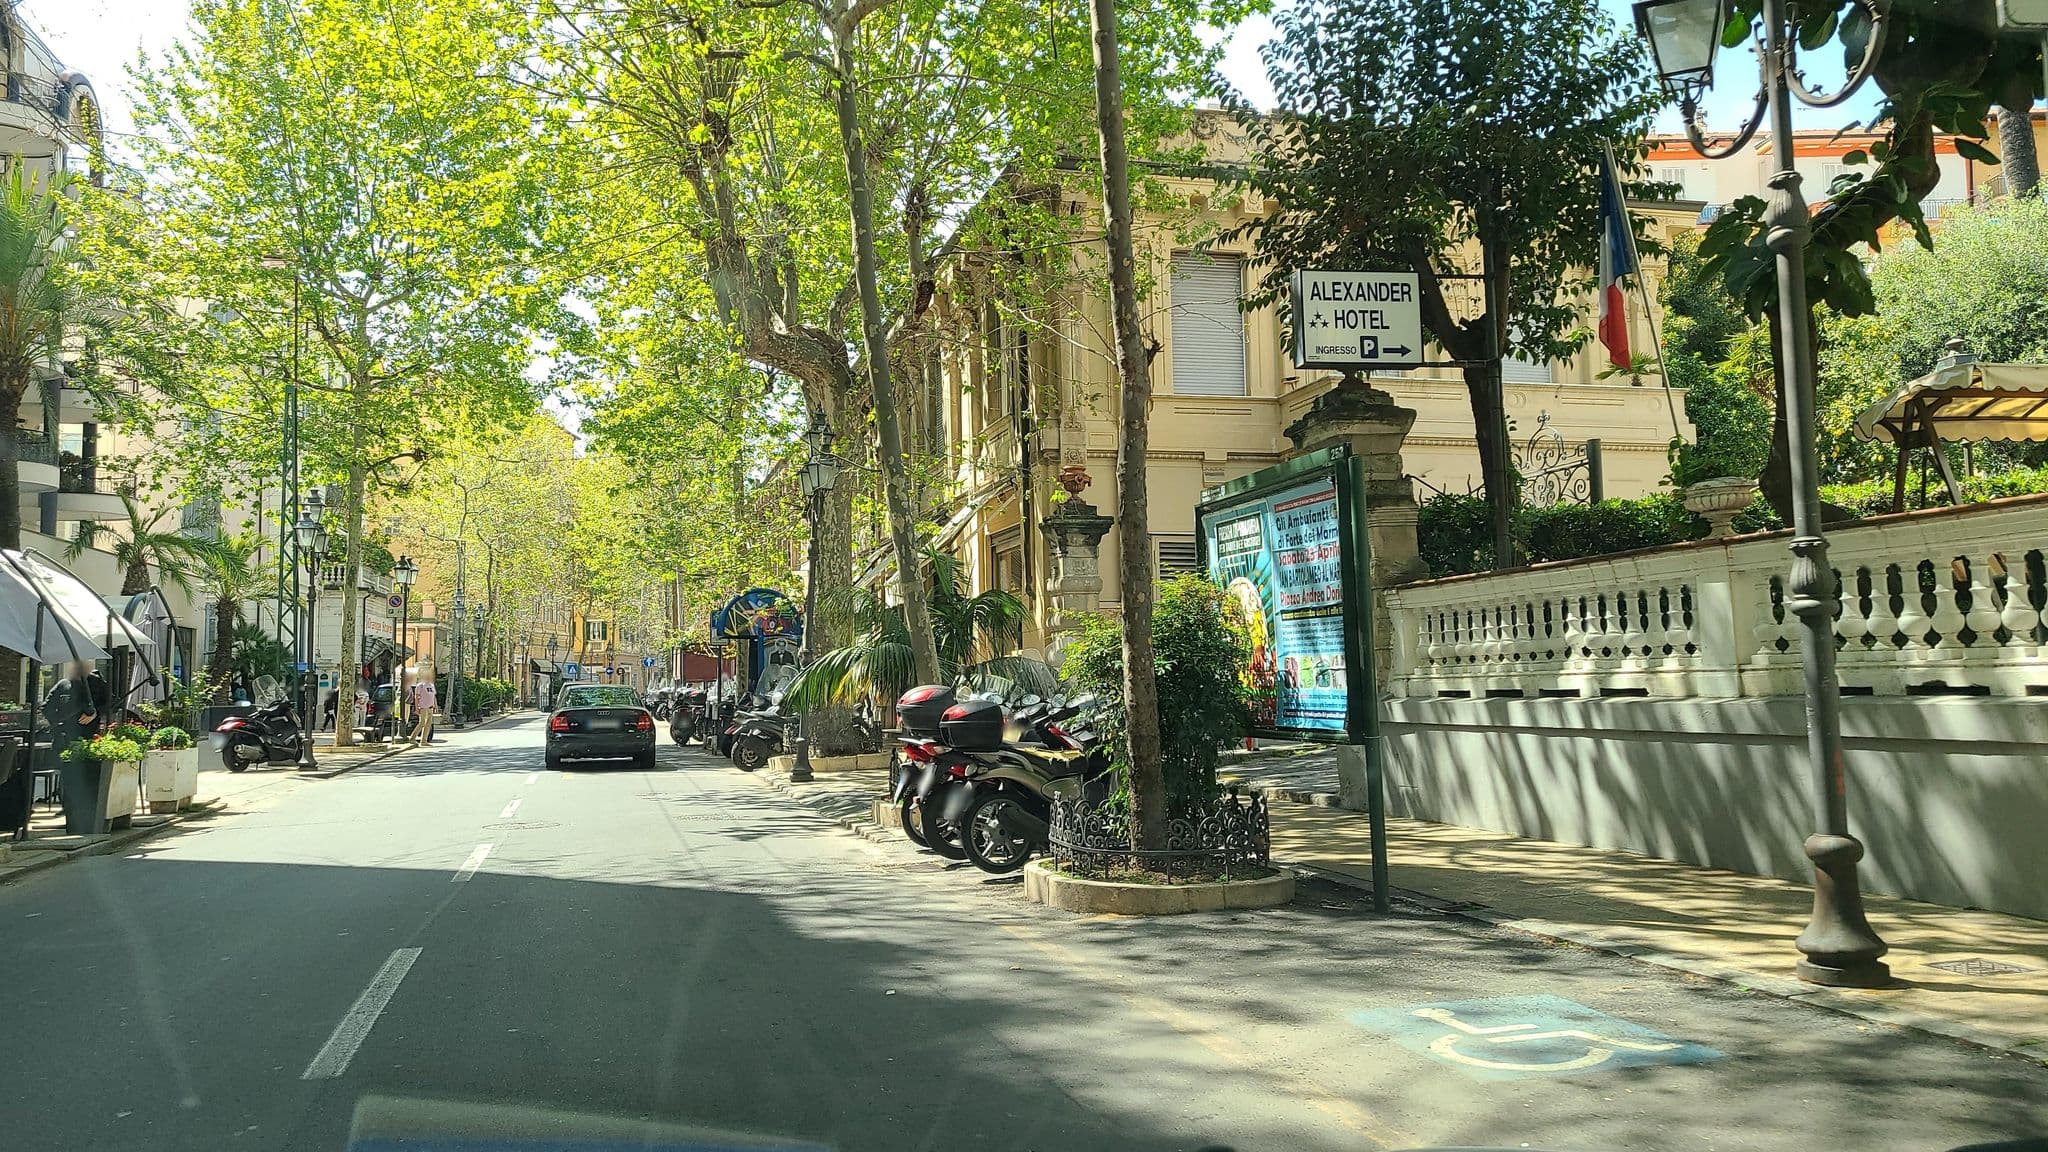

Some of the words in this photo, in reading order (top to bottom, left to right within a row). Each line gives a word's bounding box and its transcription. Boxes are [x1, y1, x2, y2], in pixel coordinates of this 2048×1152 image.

[1310, 281, 1412, 303] ALEXANDER
[1334, 309, 1390, 330] HOTEL
[1315, 345, 1357, 355] INGRESSO
[1363, 339, 1376, 355] P
[1276, 516, 1287, 532] Gli
[1288, 508, 1329, 529] Ambulanti
[1278, 535, 1285, 549] di
[1285, 533, 1303, 547] Forte
[1304, 529, 1316, 543] dei
[1316, 526, 1339, 540] Marm
[1279, 549, 1304, 566] Sabato
[1329, 560, 1341, 581] MAR
[1280, 591, 1301, 606] Piazza
[1302, 586, 1325, 604] Andrea
